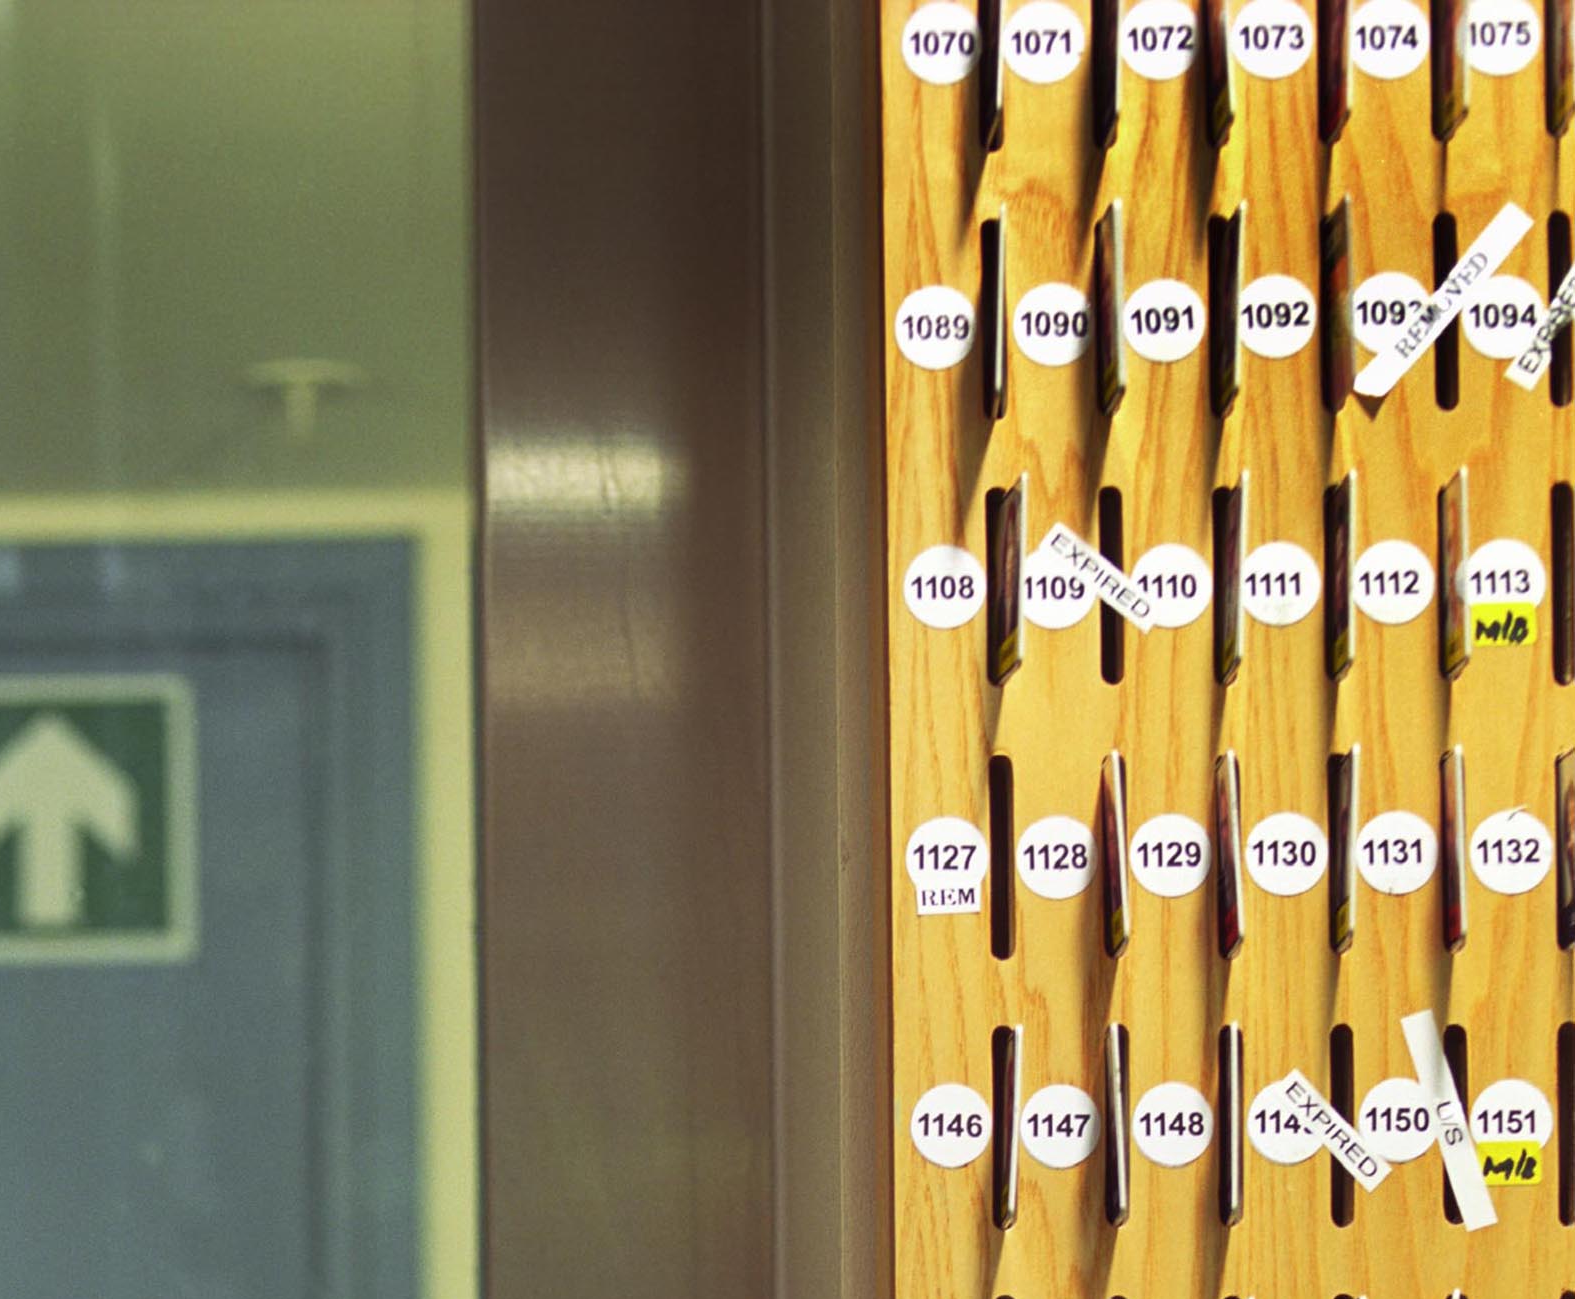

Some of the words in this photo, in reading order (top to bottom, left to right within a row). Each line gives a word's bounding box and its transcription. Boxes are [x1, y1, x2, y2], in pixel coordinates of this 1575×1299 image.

[910, 31, 975, 57] 1070
[1012, 29, 1071, 55] 1071
[1129, 27, 1193, 51] 1072
[1240, 25, 1305, 50] 1073
[1356, 25, 1418, 50] 1074
[1469, 21, 1531, 47] 1075
[903, 314, 971, 340] 1089
[1022, 312, 1088, 338] 1090
[1131, 306, 1194, 334] 1091
[1241, 301, 1310, 329] 1092
[1470, 305, 1537, 328] 1094
[911, 575, 975, 600] 1108
[1026, 576, 1085, 599] 1109
[1051, 532, 1151, 620] EXPIRED
[1138, 576, 1196, 598] 1110
[1245, 572, 1301, 596] 1111
[1359, 570, 1419, 595] 1112
[1470, 569, 1530, 594] 1113
[913, 844, 977, 870] 1127
[1023, 843, 1088, 871] 1128
[1137, 841, 1202, 868] 1129
[1252, 840, 1317, 867] 1130
[1363, 838, 1422, 865] 1131
[1477, 838, 1540, 864] 1132
[922, 889, 976, 905] REM
[918, 1113, 983, 1138] 1146
[1027, 1113, 1092, 1138] 1147
[1139, 1111, 1205, 1137] 1148
[1255, 1110, 1312, 1134] 114
[1285, 1080, 1378, 1181] EXPIRED
[1366, 1108, 1429, 1133] 1150
[1477, 1109, 1535, 1134] 1151
